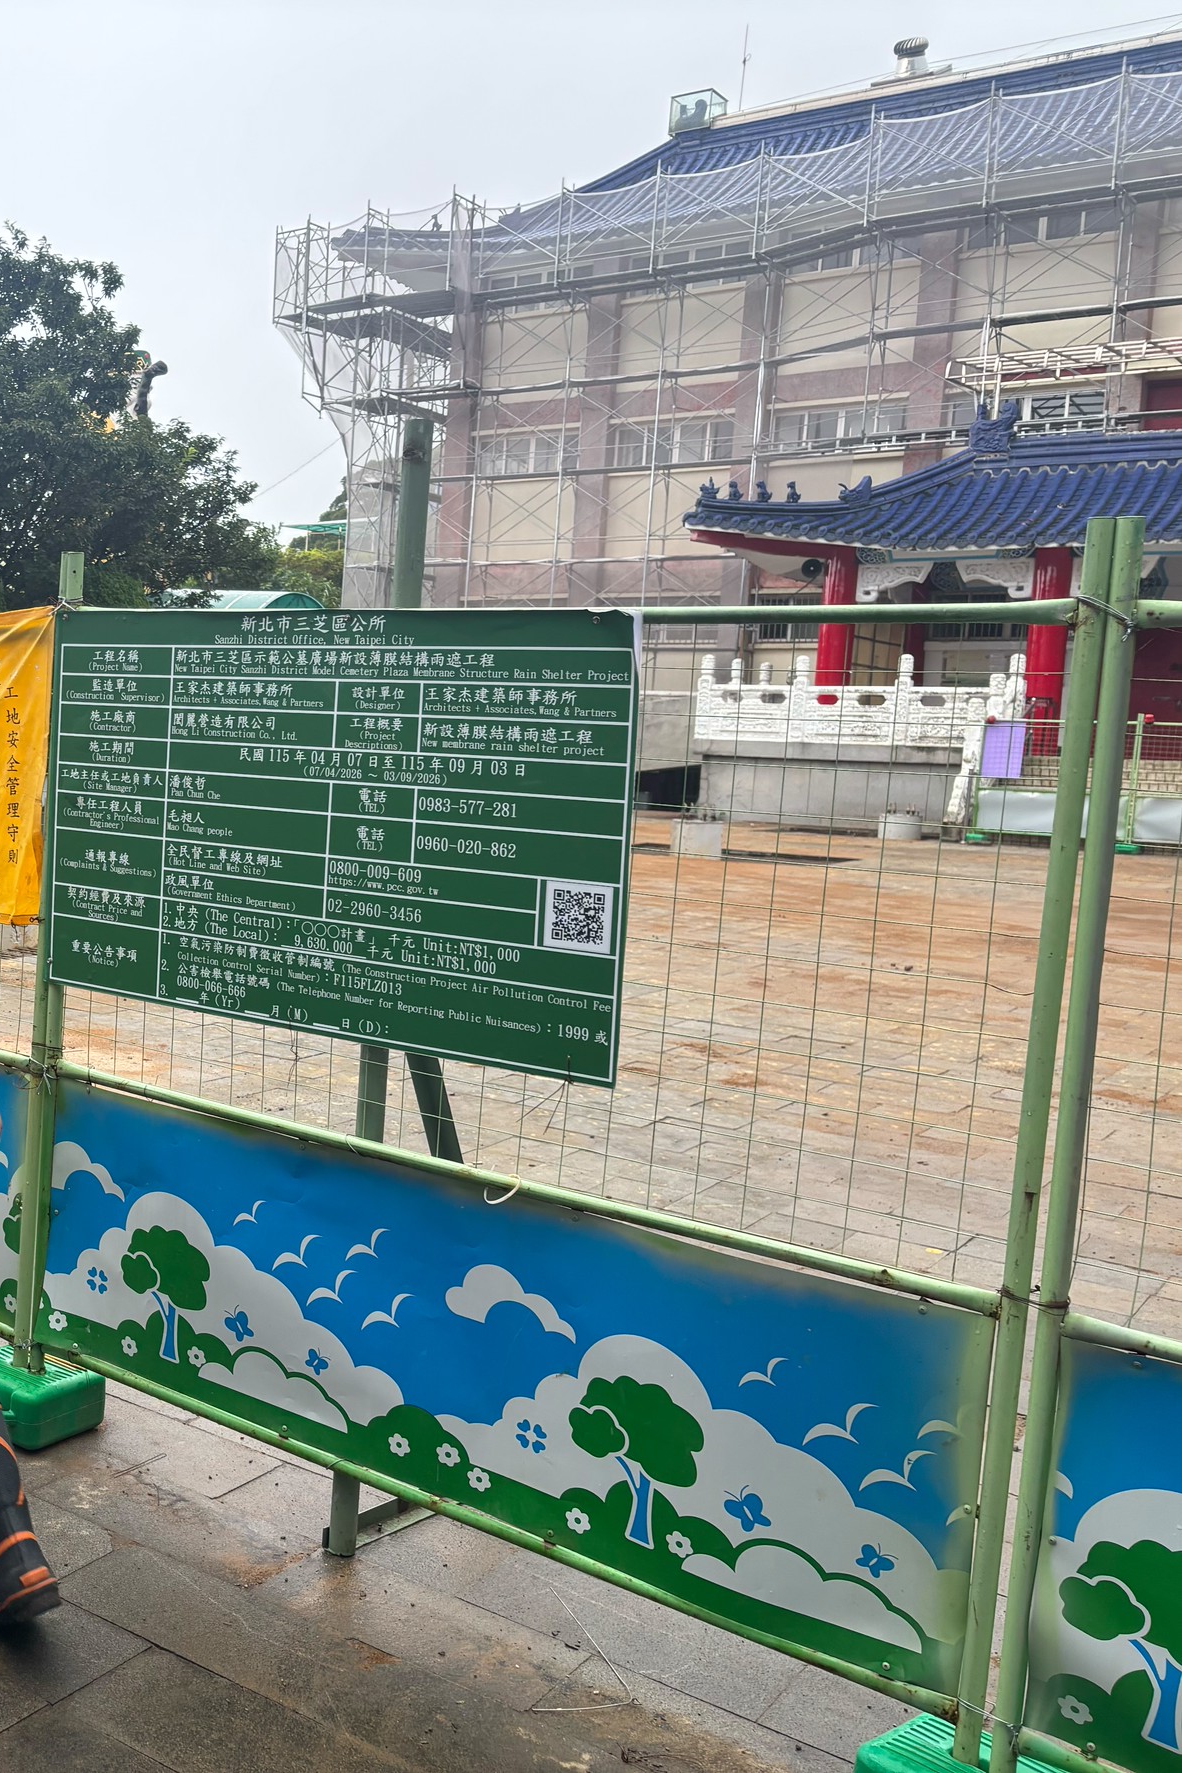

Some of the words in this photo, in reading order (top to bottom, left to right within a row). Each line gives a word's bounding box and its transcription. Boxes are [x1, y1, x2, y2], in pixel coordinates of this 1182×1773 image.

[240, 614, 386, 633] 新北市三芝區公所
[214, 634, 242, 644] Sanzhi
[248, 634, 287, 644] District
[292, 634, 325, 644] Office,
[333, 634, 349, 644] New
[354, 634, 385, 645] Taipei
[391, 635, 414, 645] City
[92, 649, 139, 662] 工程名稱
[176, 649, 494, 668] 新北市三芝區示範公墓廣場新設薄膜結構雨遮工程
[88, 662, 118, 671] (Project
[122, 662, 142, 672] Name)
[174, 662, 186, 672] New
[191, 662, 214, 673] Taipei
[219, 663, 237, 674] City
[241, 664, 266, 673] Sanzhi
[270, 664, 307, 674] District
[312, 664, 334, 675] Model
[340, 666, 378, 677] Cemetery
[383, 666, 408, 676] Plaza
[413, 667, 454, 677] Membrane
[459, 667, 508, 678] Structure
[514, 668, 536, 678] Rain
[541, 669, 582, 680] Shelter
[588, 670, 628, 682] Project
[92, 678, 137, 692] 監造單位
[174, 680, 293, 697] 王家杰建築師事務所
[351, 686, 405, 700] 設計單位
[66, 690, 114, 700] (Construction
[120, 692, 164, 702] Supervisor)
[425, 686, 577, 706] 王家杰建築師事務所
[355, 700, 400, 710] (Designer)
[423, 702, 470, 712] Architects
[574, 706, 616, 717] Partners
[89, 709, 135, 724] 施工廠商
[349, 717, 403, 731] 工程概要
[89, 722, 135, 732] (Contractor)
[360, 730, 395, 740] (Project
[423, 722, 592, 744] 新設薄膜結構雨遮工程
[88, 740, 134, 755] 施工期間
[344, 739, 402, 751] Descriptions)
[421, 737, 437, 746] New
[442, 739, 485, 749] membrane
[491, 741, 512, 750] rain
[518, 742, 558, 753] shelter
[563, 745, 604, 756] project
[92, 752, 130, 763] (Duration)
[239, 747, 263, 761] 民國
[269, 748, 289, 762] 115
[311, 750, 324, 764] 04
[347, 752, 362, 766] 07
[401, 755, 424, 770] 115
[449, 758, 465, 773] 09
[490, 760, 507, 775] 03
[4, 687, 21, 865] 工地安全管理守則
[61, 768, 162, 785] 工地主任或工地負責人
[169, 774, 206, 789] 潘俊哲
[83, 780, 102, 790] (Site
[105, 782, 136, 793] Manager)
[171, 787, 183, 796] Pan
[187, 789, 203, 798] Chun
[207, 790, 220, 799] Che
[358, 787, 387, 802] 電話
[75, 795, 141, 815] 專任工程人員
[358, 802, 384, 814] (TEL)
[418, 796, 516, 817] 0983-577-281
[356, 825, 384, 840] 電話
[356, 839, 382, 851] (TEL)
[416, 835, 516, 858] 0960-020-862
[84, 848, 129, 865] 通報專線
[166, 843, 282, 868] 全民督工專線及網址
[329, 860, 421, 883] 0800-009-609
[165, 873, 214, 890] 政風單位
[67, 886, 147, 908] 契約經費及來源
[167, 886, 212, 899] (Government
[216, 892, 242, 903] Ethics
[246, 896, 295, 911] Department)
[327, 898, 421, 922] 02-2960-3456
[205, 907, 228, 922] (The
[388, 933, 415, 948] 千元
[204, 921, 227, 935] (The
[365, 943, 393, 960] 千元
[71, 939, 136, 962] 重要公告事項
[88, 954, 120, 967] (Notice)
[177, 951, 218, 965] Collection
[222, 958, 251, 971] Control
[256, 964, 282, 976] Serial
[176, 974, 245, 997] 0800-066-666
[342, 963, 361, 974] (The
[365, 966, 426, 984] Construction
[430, 976, 466, 990] Project
[471, 983, 488, 993] Air
[492, 985, 543, 1002] Pollution
[547, 994, 586, 1008] Control
[593, 1000, 612, 1013] Fee
[178, 962, 270, 989] 公害檢舉電話號碼
[276, 981, 294, 992] (The
[298, 984, 340, 1000] Telephone
[344, 992, 374, 1005] Number
[379, 998, 393, 1008] for
[397, 1000, 444, 1018] Reporting
[448, 1009, 481, 1023] Public
[594, 1030, 608, 1045] 或
[215, 994, 239, 1009] (Yr)
[287, 1006, 307, 1022] (M)
